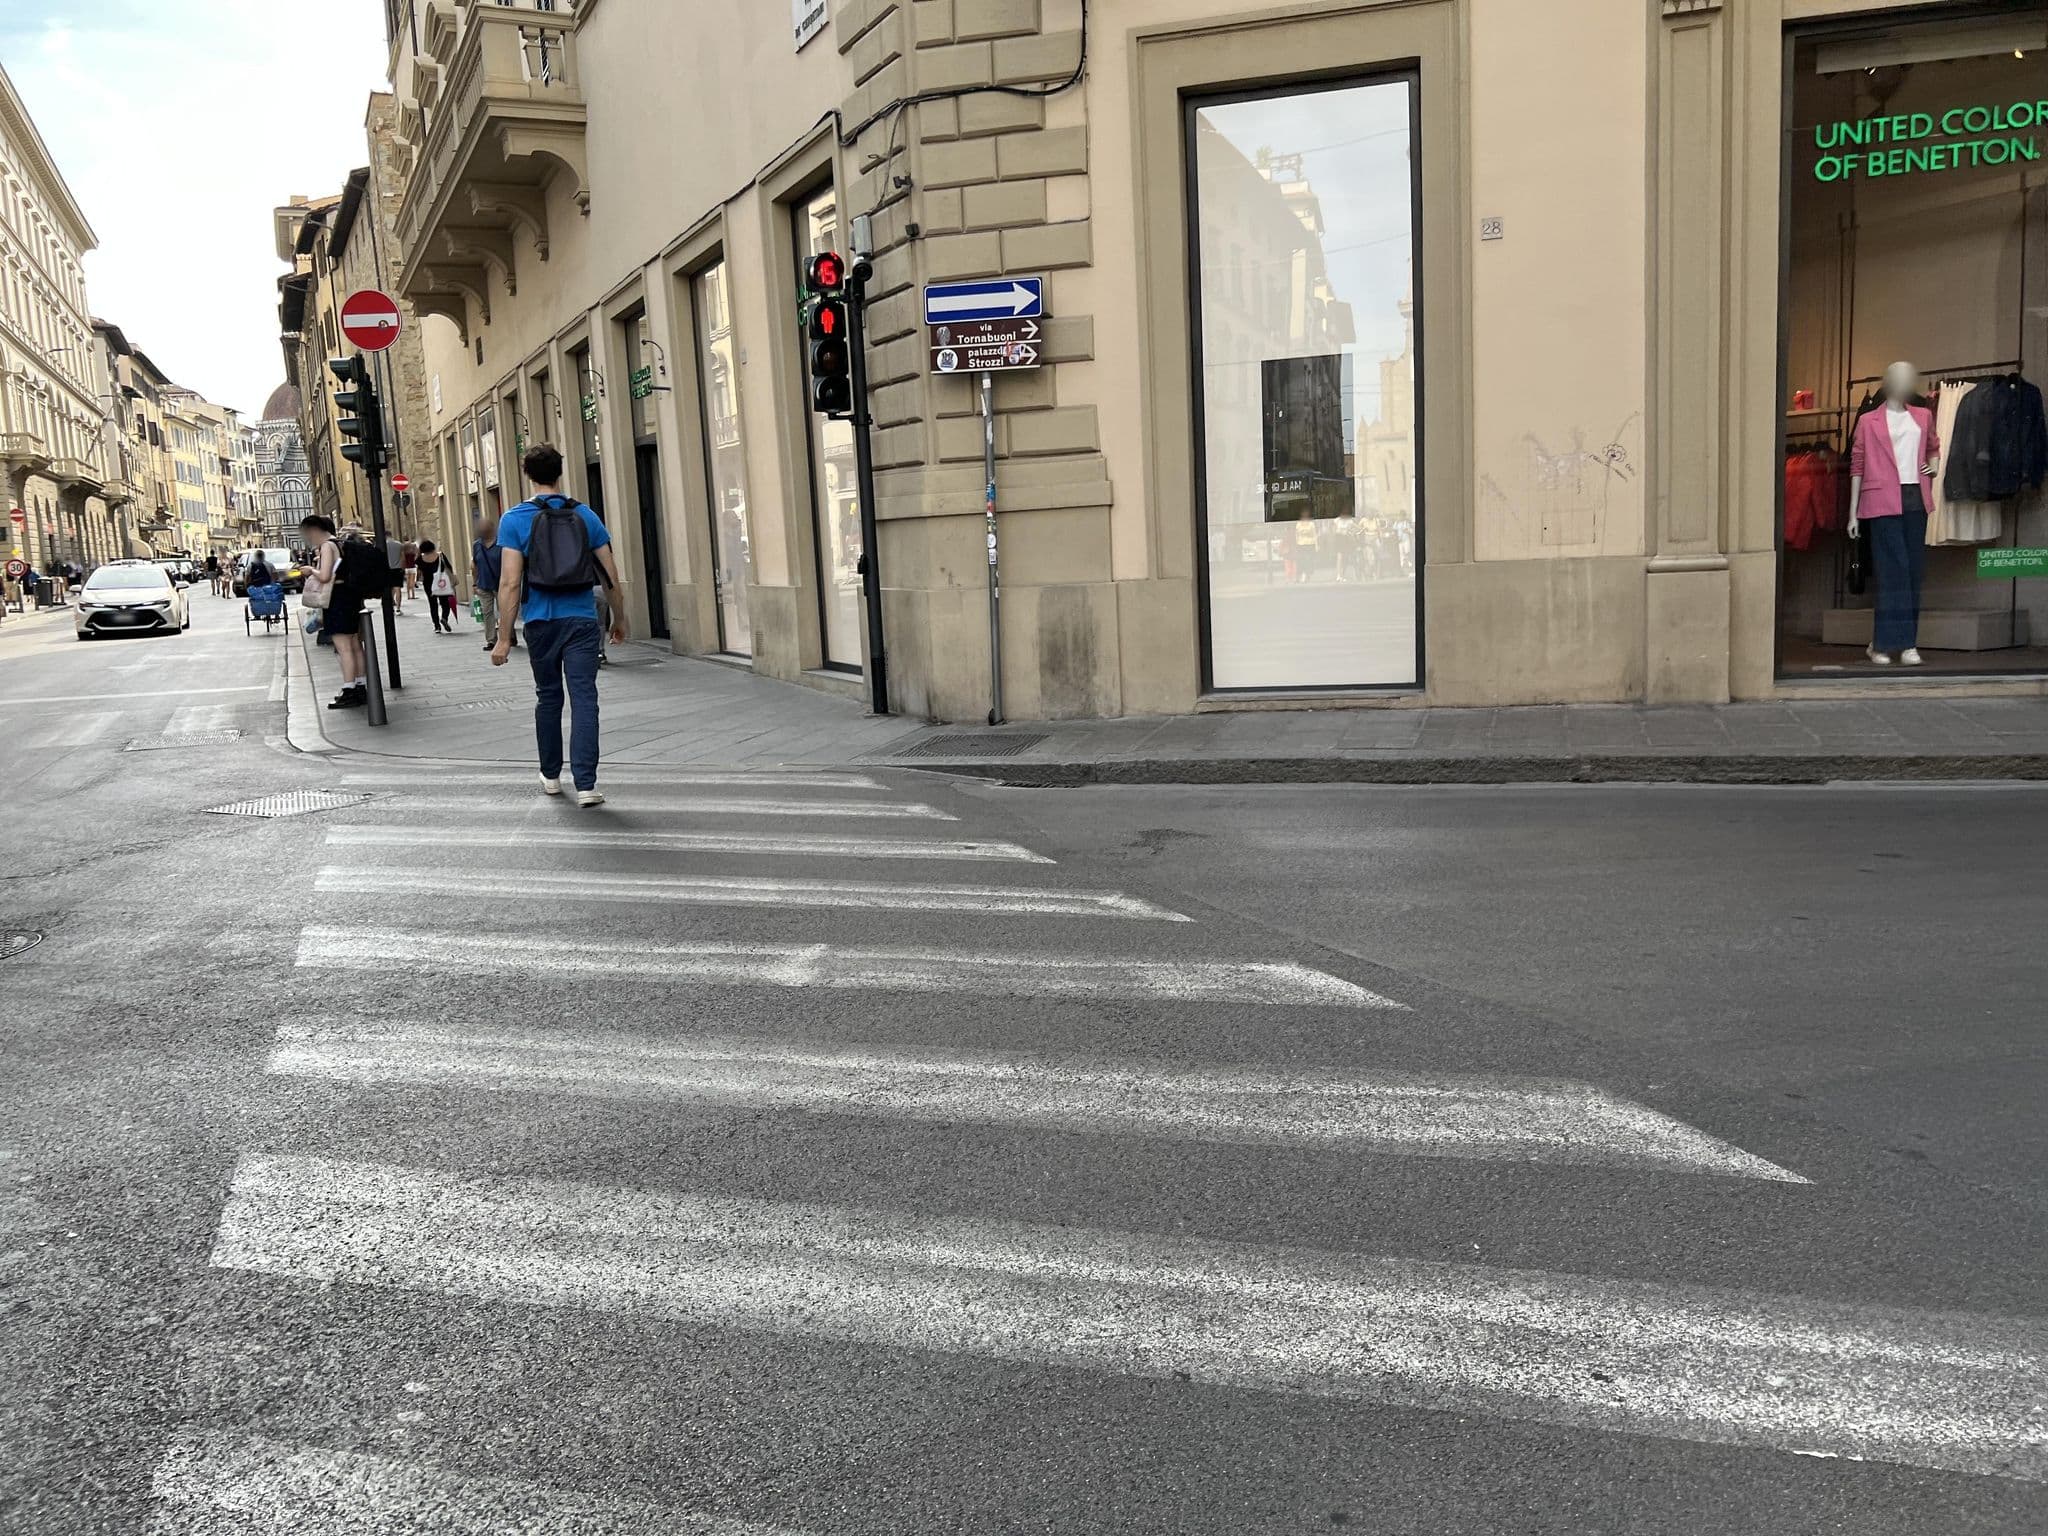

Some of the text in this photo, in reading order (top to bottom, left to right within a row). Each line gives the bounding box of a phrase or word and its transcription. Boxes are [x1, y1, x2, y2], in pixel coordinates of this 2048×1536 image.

[1815, 113, 1934, 149] UNITED
[1814, 155, 1858, 182] OF
[1482, 221, 1501, 235] 28
[979, 323, 992, 332] via
[957, 331, 1016, 344] Tornabuoni
[968, 356, 1004, 368] Strozzi
[1979, 550, 2014, 559] UNITED
[11, 563, 22, 572] 30
